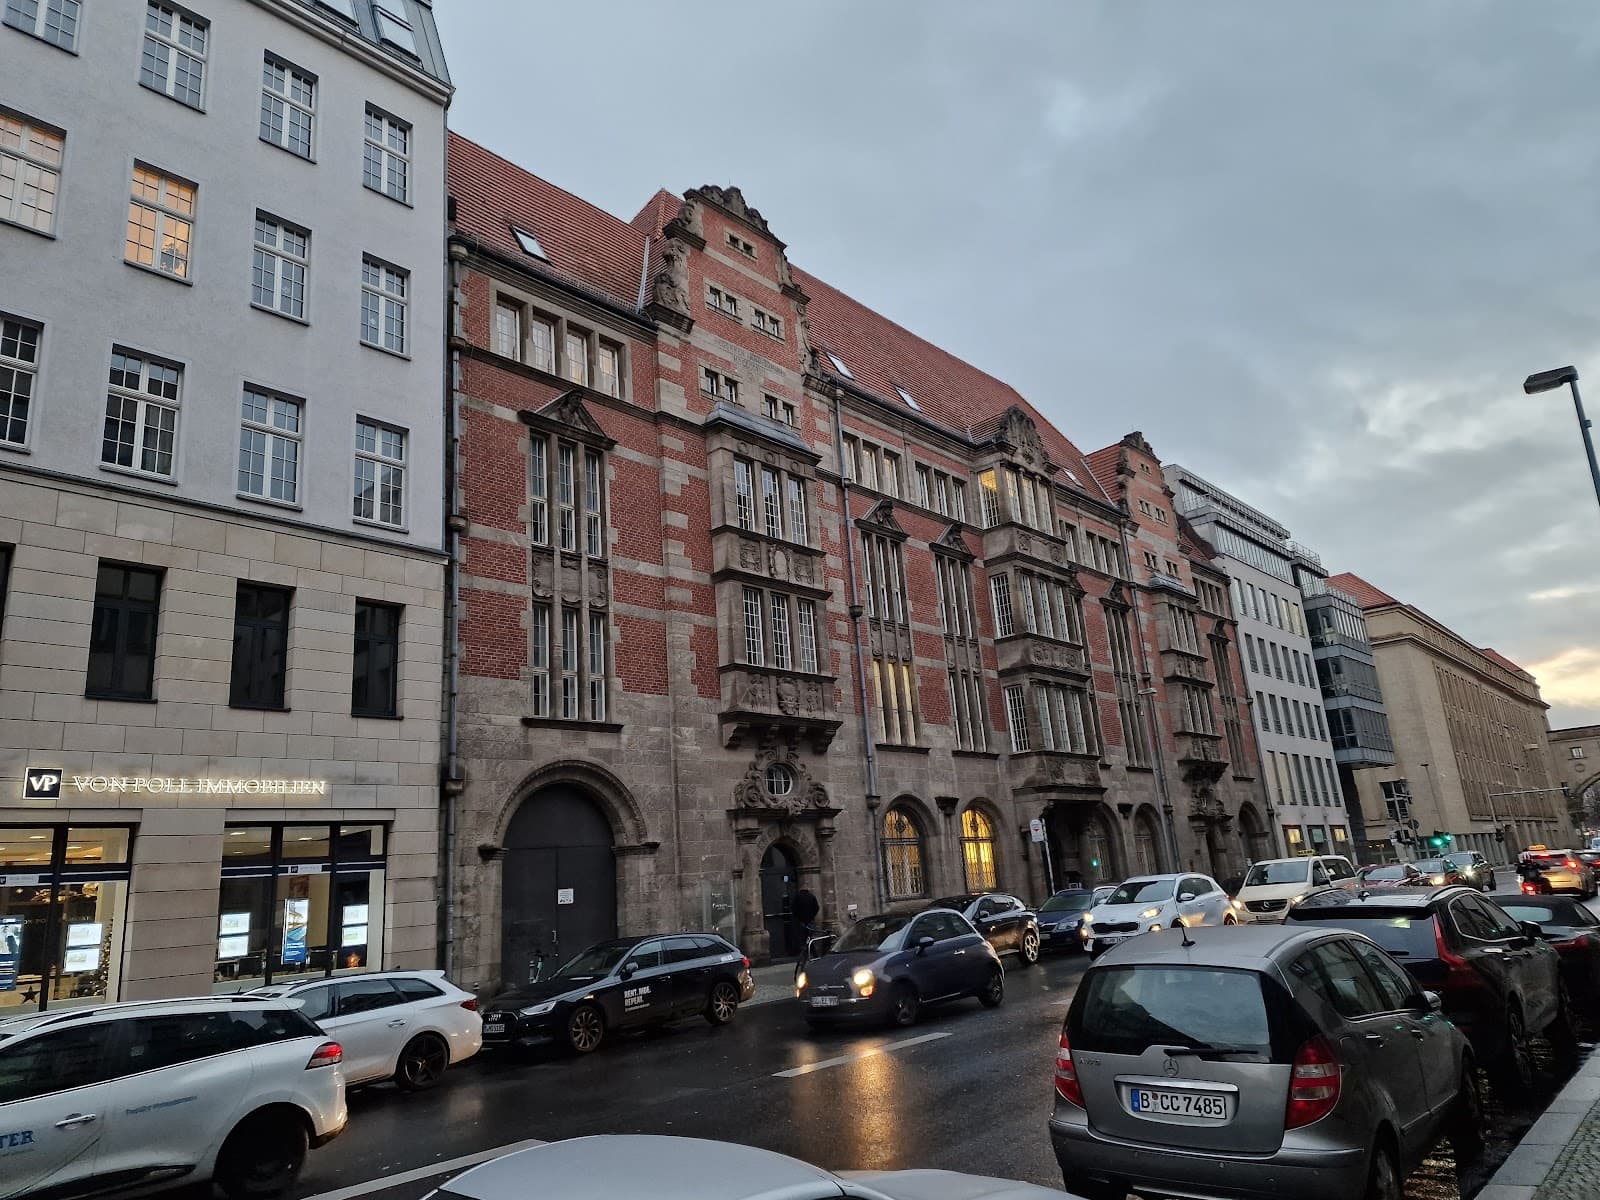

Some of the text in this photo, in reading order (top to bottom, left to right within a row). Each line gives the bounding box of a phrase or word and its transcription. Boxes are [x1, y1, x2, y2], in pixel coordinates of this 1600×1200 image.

[29, 774, 58, 792] VP
[73, 775, 327, 795] VON POLL IMMOBILIEN
[1140, 1092, 1223, 1116] B CC 7485
